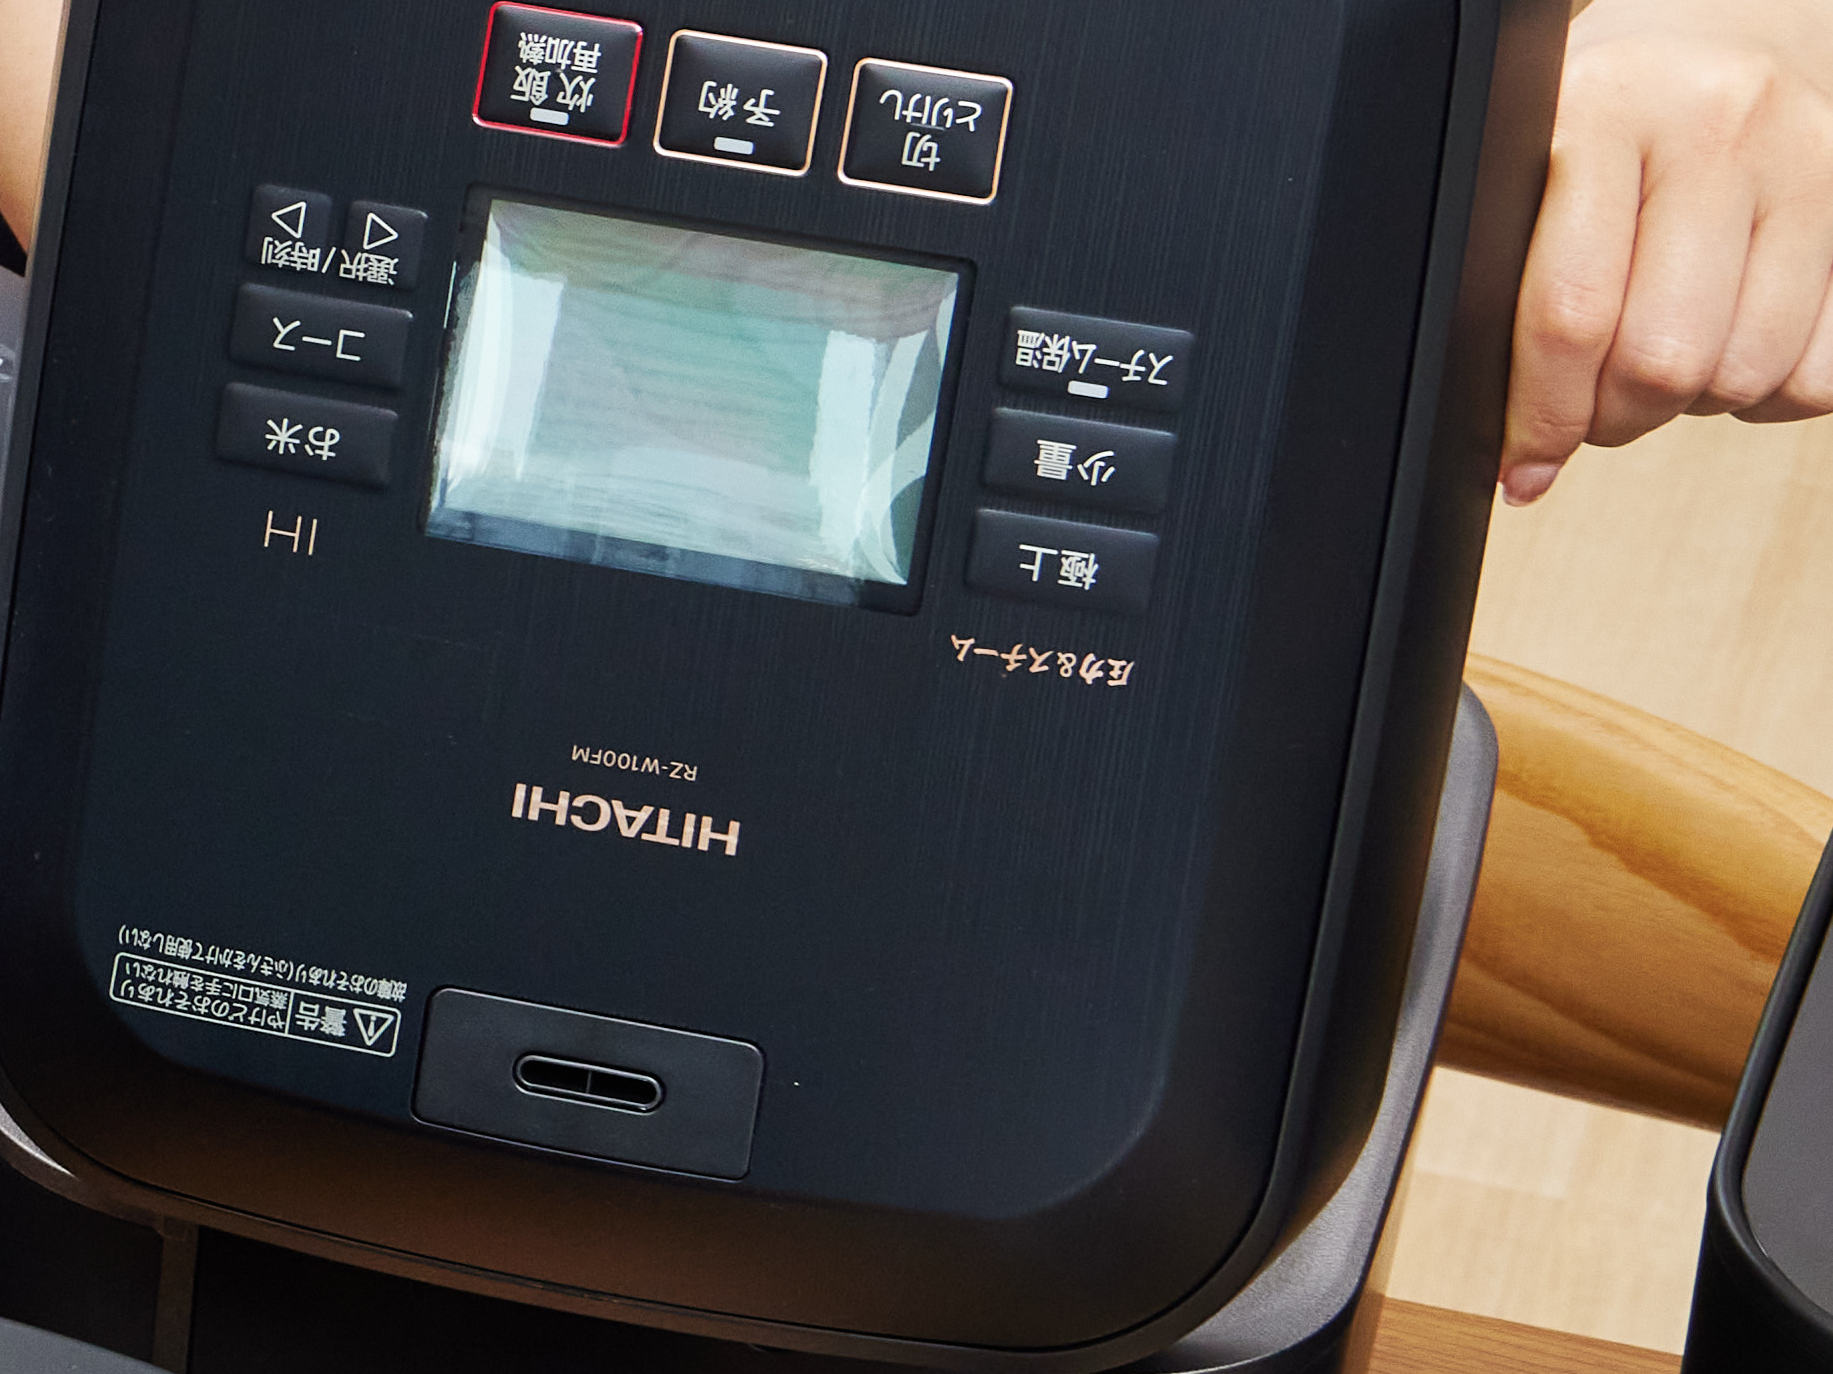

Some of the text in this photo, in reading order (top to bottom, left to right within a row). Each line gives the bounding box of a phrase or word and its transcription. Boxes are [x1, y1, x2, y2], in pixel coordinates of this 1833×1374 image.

[514, 29, 602, 72] 再加熱
[508, 62, 594, 111] 炊飯
[695, 78, 782, 126] 予約
[876, 86, 982, 131] とりけし
[901, 128, 942, 173] 切
[267, 314, 366, 361] コース
[1013, 327, 1174, 386] スチーム保温
[261, 412, 342, 461] お米
[1031, 434, 1116, 486] 少量
[262, 509, 318, 556] IH
[1015, 538, 1100, 591] 極上
[569, 741, 699, 784] RZ-W100FM
[508, 780, 743, 856] HITACHI
[118, 976, 286, 1033] やけどのおそれあり
[295, 1002, 349, 1041] 警告
